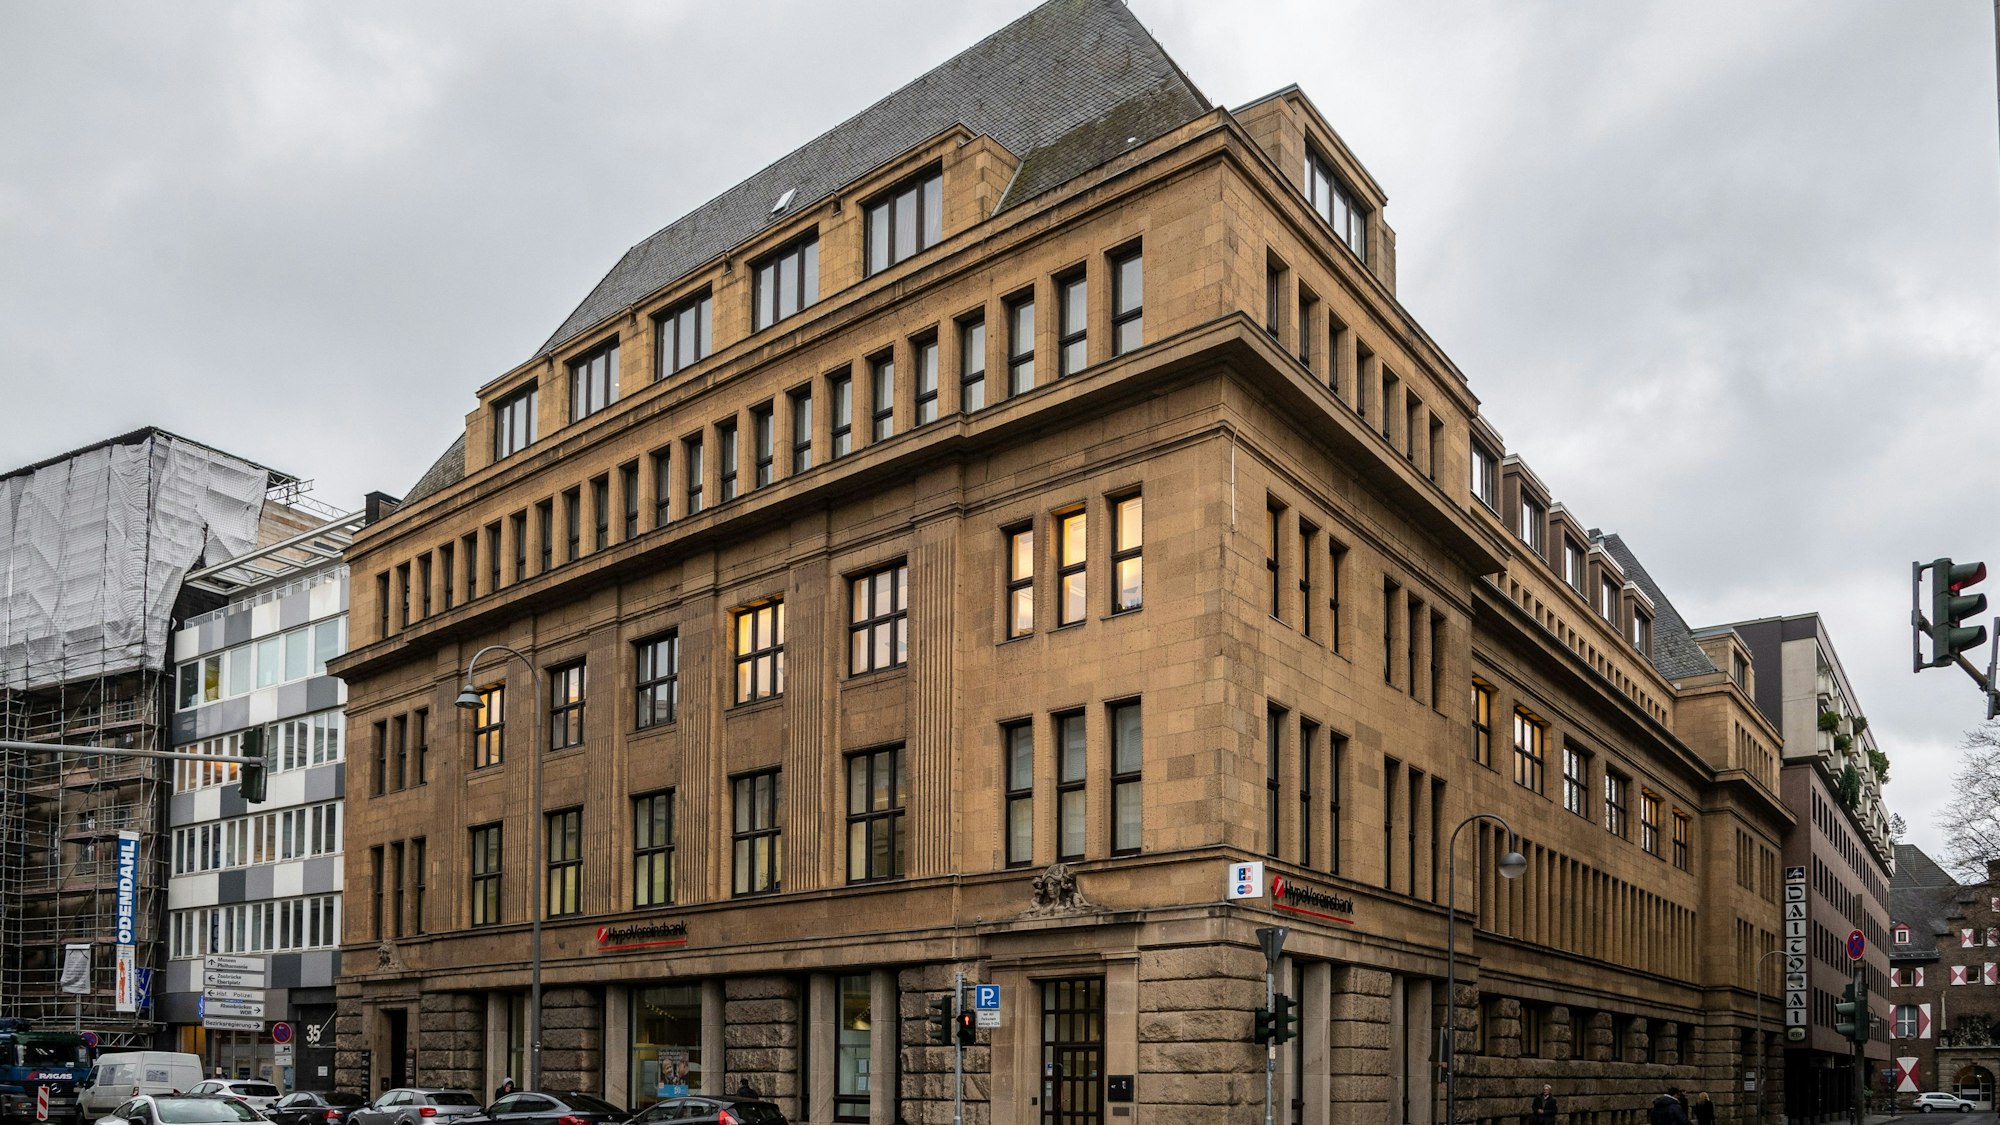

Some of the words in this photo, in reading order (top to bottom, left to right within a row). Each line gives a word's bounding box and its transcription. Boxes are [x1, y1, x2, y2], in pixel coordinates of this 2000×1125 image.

[118, 840, 135, 944] ODENDAHL
[1284, 879, 1354, 915] HypoVereinsbank
[608, 919, 688, 944] HypoVereinsbank
[981, 987, 994, 1006] P
[205, 1020, 252, 1029] Bezirksregierung
[306, 1024, 321, 1042] 35
